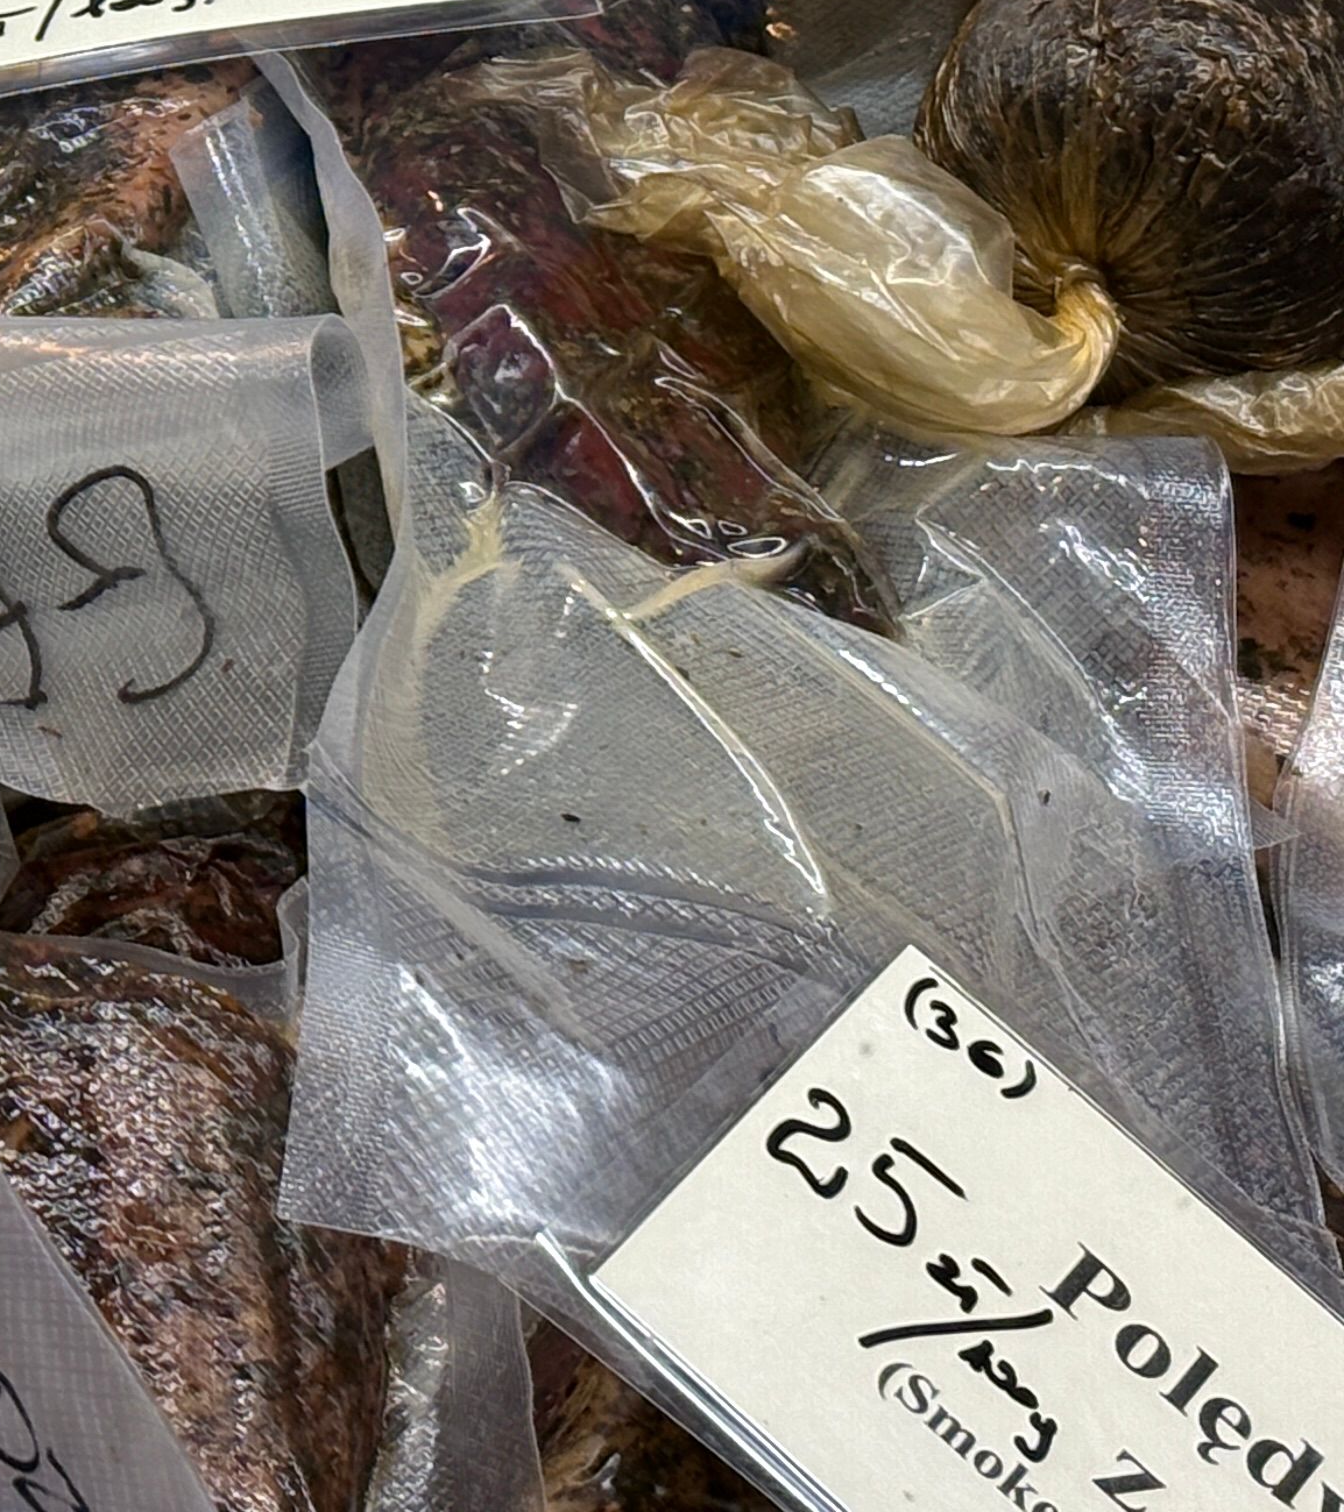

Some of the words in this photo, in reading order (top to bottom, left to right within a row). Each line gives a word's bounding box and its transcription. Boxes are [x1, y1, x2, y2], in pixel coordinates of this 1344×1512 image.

[905, 978, 1036, 1099] (36)
[766, 1088, 965, 1247] 25
[1039, 1242, 1344, 1510] Polęd
